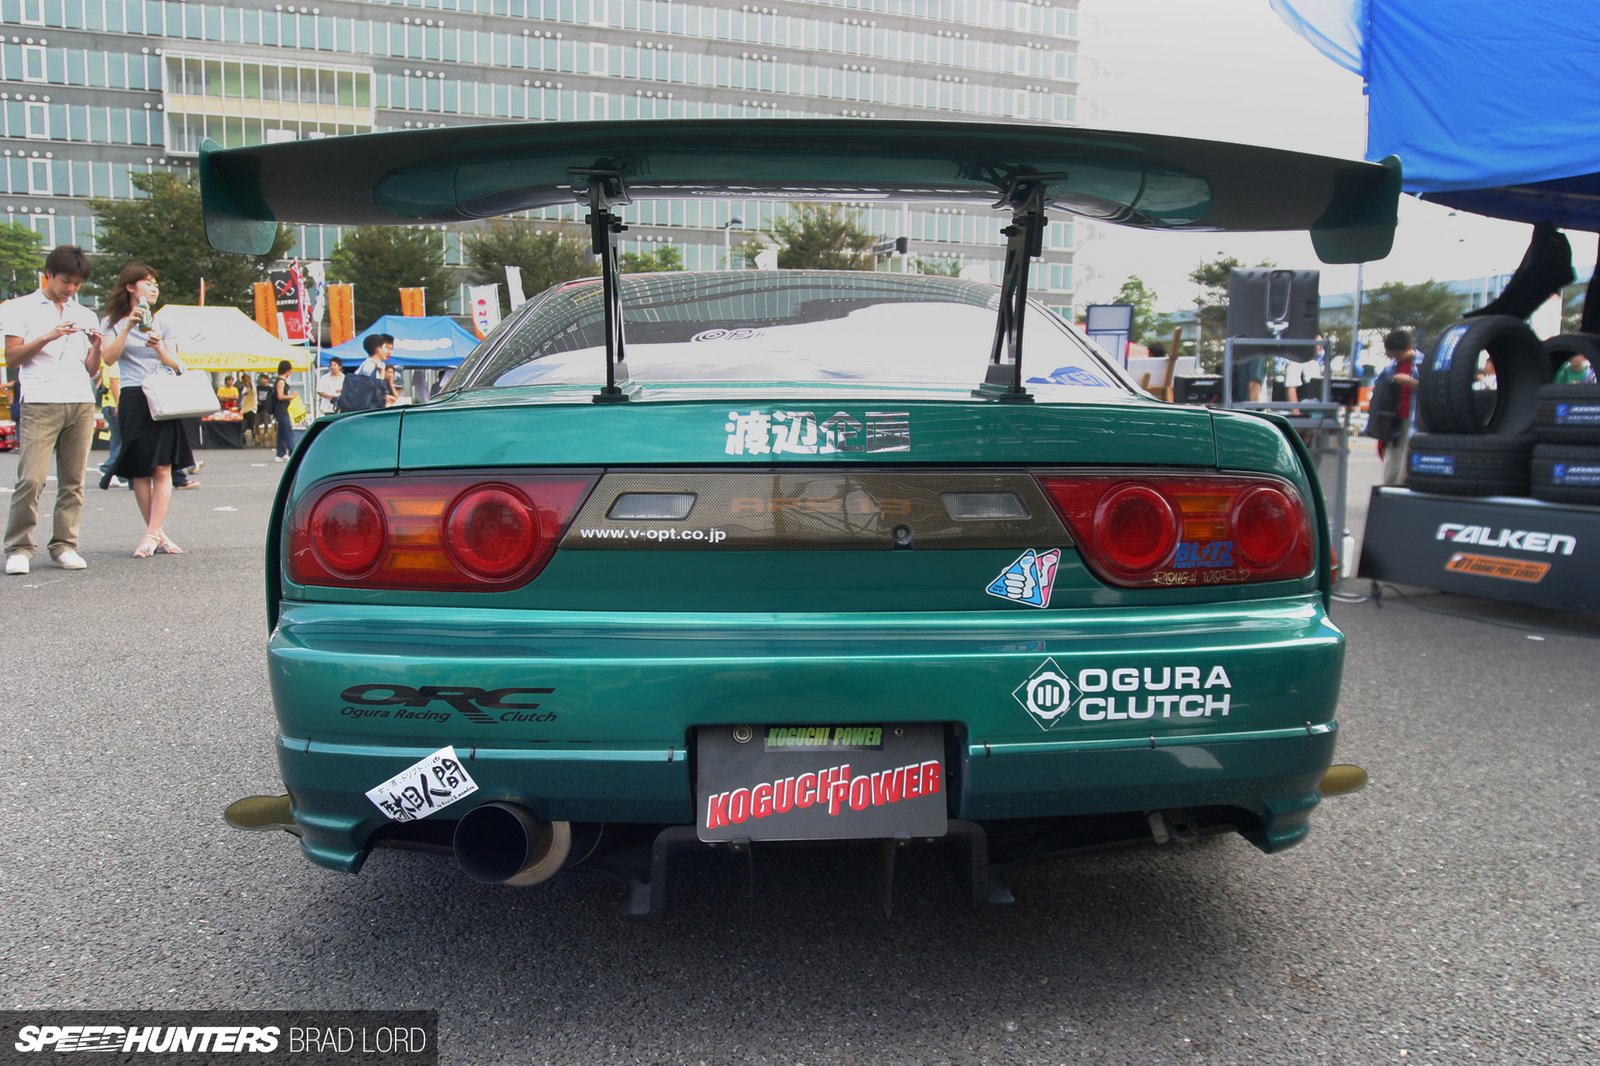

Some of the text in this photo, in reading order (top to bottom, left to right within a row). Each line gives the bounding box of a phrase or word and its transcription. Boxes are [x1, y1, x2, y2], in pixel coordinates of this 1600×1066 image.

[725, 410, 911, 455] 渡辺企画
[580, 526, 727, 544] www.v-opt.co.jp
[1435, 522, 1577, 556] FALKEN
[1078, 665, 1232, 693] OGURA
[340, 683, 557, 720] ORC
[340, 706, 557, 724] Ogura Racing Clutch
[1078, 694, 1232, 721] CLUTCH
[766, 727, 883, 747] KOGUCHI POWER
[706, 759, 941, 830] KOGUCHI POWER
